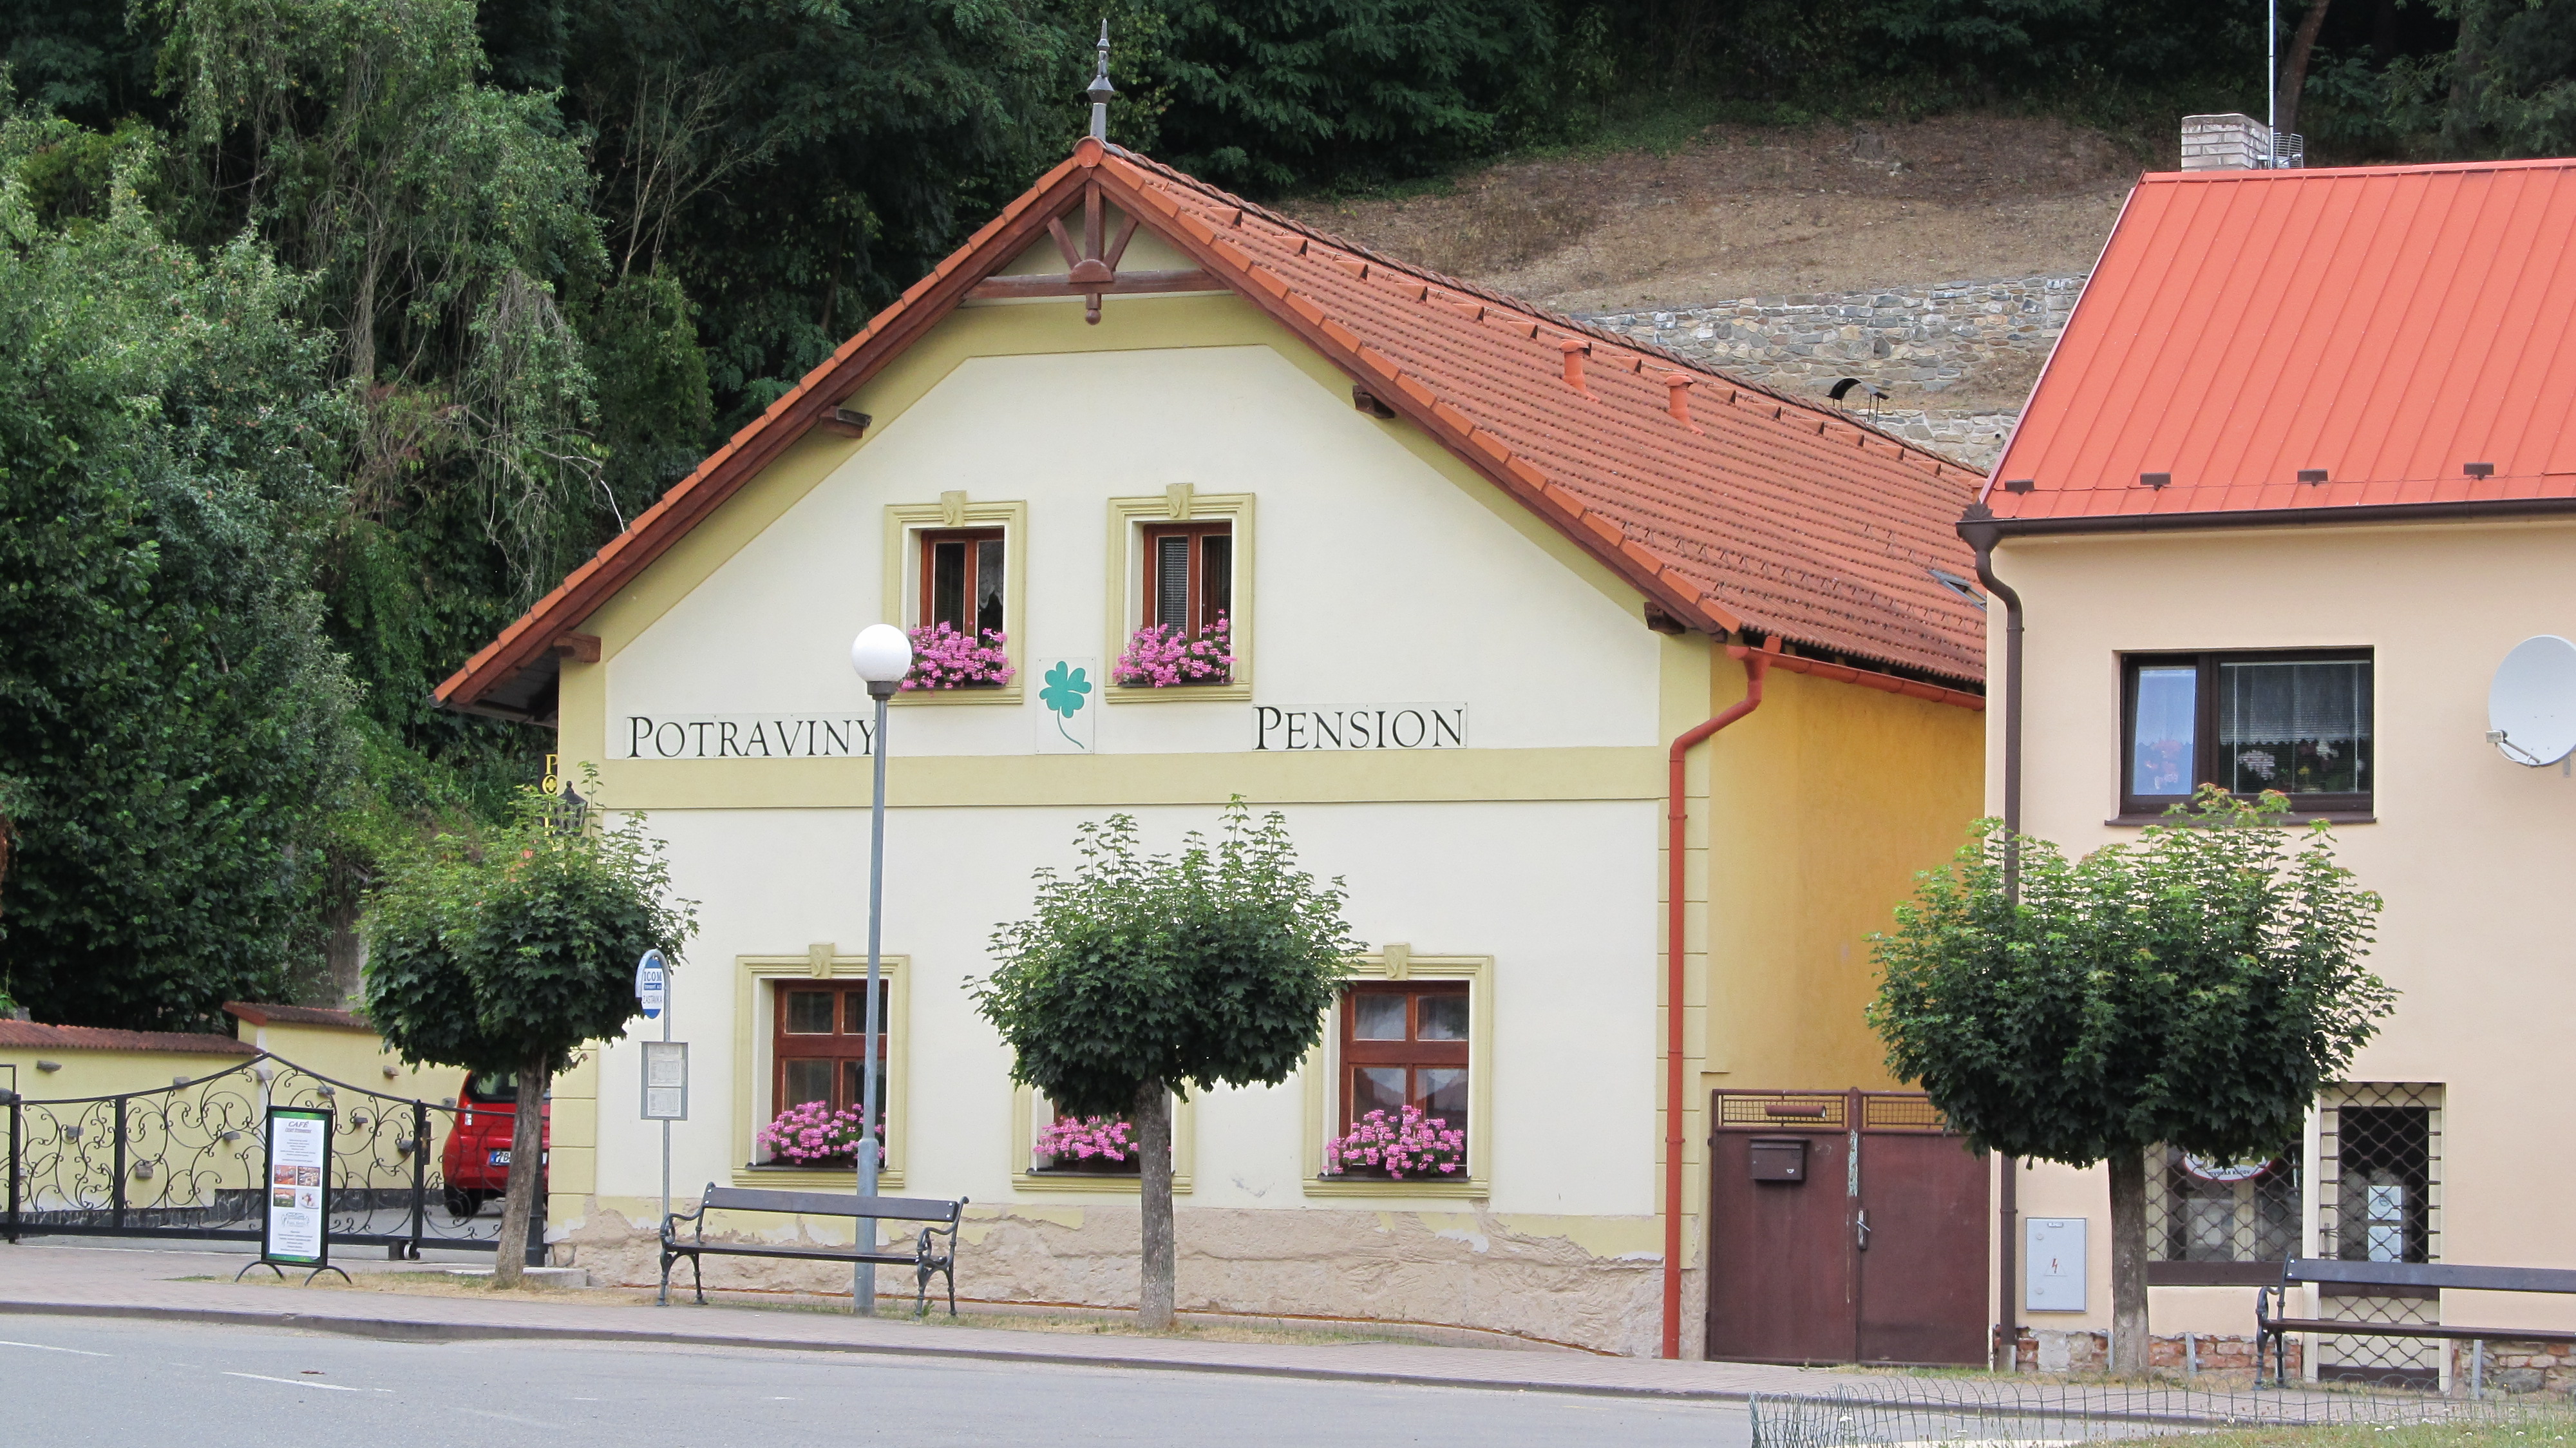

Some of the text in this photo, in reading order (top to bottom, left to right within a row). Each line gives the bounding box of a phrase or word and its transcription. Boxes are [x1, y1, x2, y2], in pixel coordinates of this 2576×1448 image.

[627, 716, 875, 758] POTRAVINY
[1251, 705, 1464, 751] PENSION
[644, 971, 662, 982] ICOM
